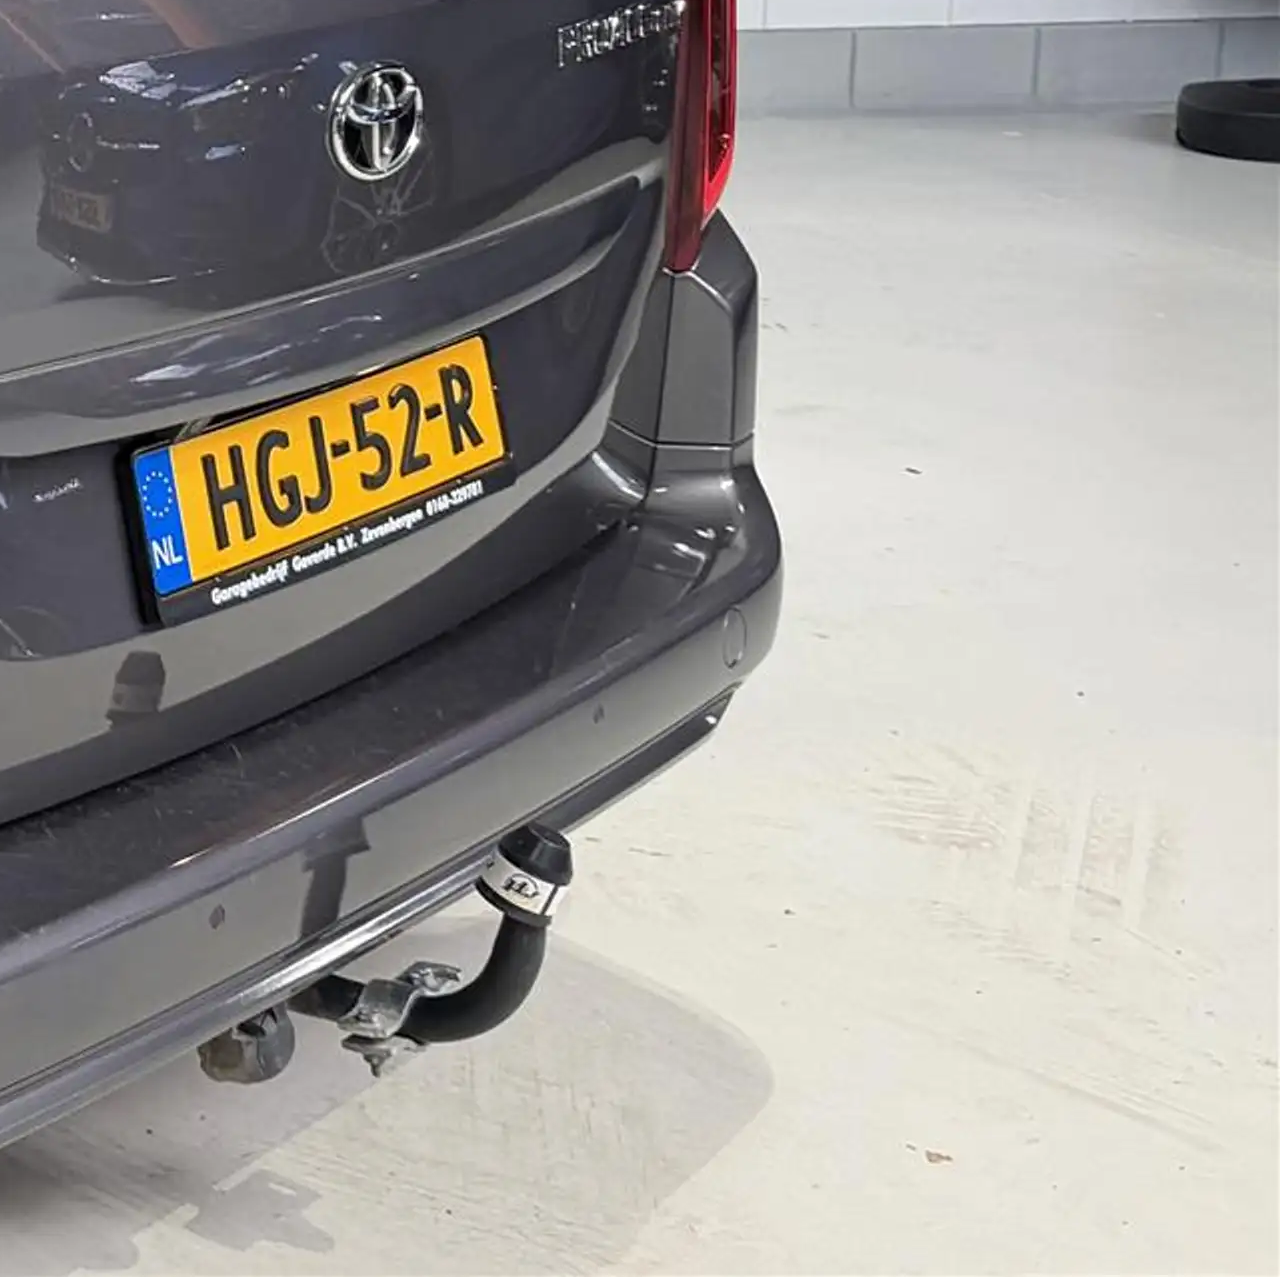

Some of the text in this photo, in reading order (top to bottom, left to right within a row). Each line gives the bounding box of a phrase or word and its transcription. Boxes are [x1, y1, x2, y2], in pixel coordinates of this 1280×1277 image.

[202, 363, 483, 551] HGJ-52-R
[151, 534, 184, 570] NL
[210, 559, 289, 605] Garagebedrijf
[291, 542, 337, 572] Goverde
[337, 532, 359, 555] B.V.
[360, 507, 424, 544] Zevenbergen
